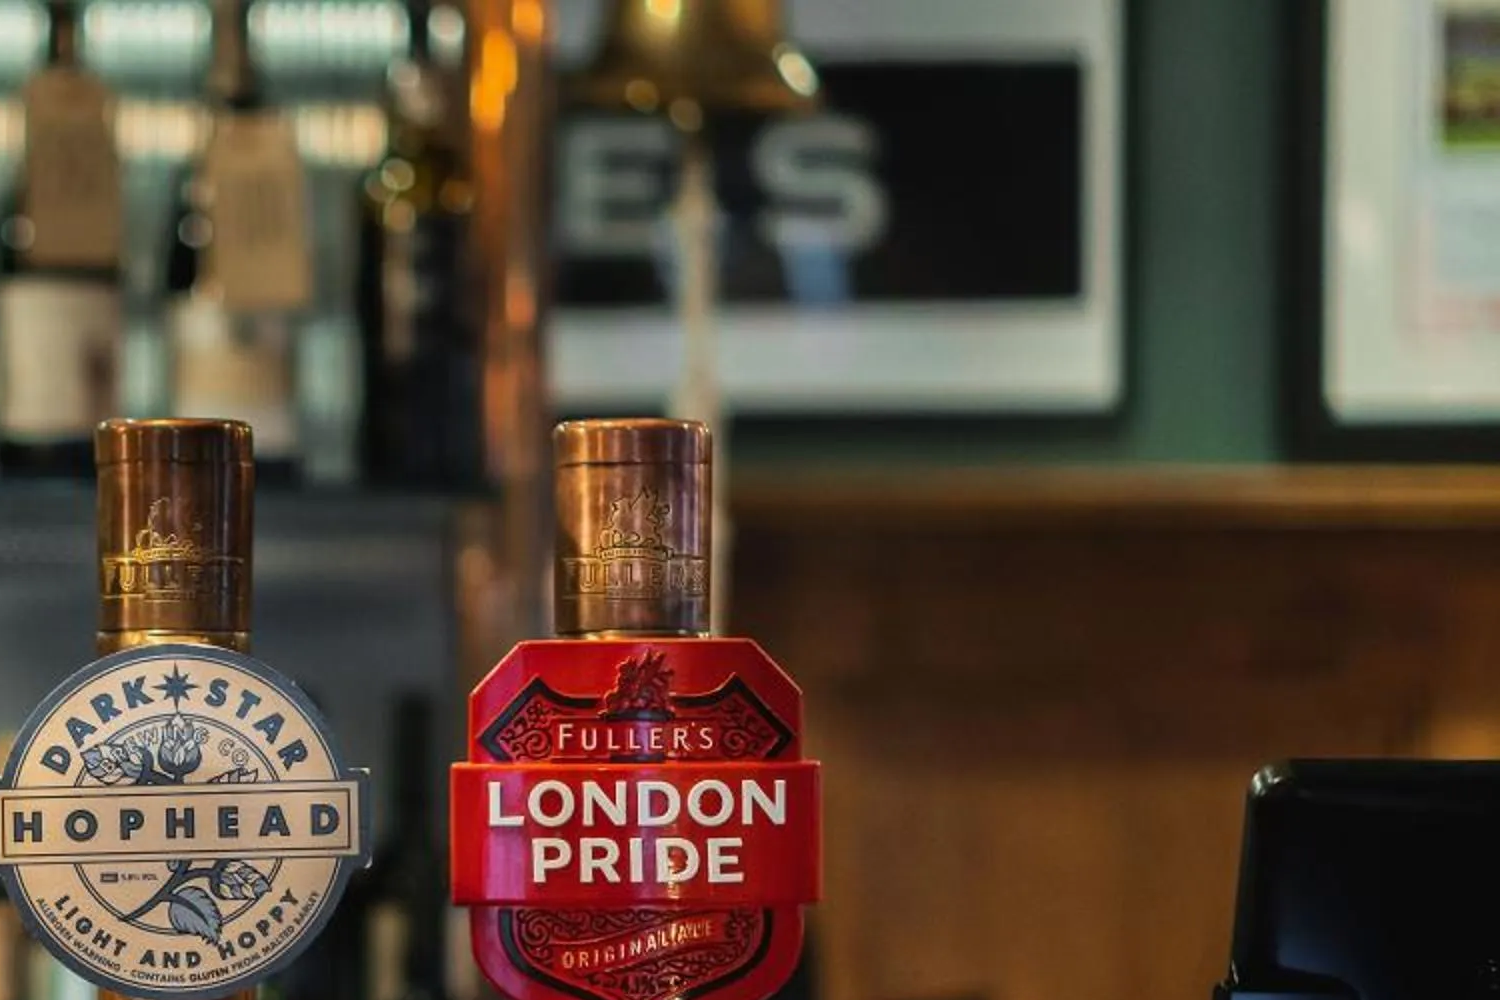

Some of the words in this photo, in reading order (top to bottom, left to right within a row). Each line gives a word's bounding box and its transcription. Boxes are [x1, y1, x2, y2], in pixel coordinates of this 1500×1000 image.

[40, 675, 156, 776] DARK
[203, 677, 309, 771] STAR
[557, 721, 715, 752] FULLER'S
[12, 803, 341, 843] HOPHEAD
[486, 779, 787, 828] LONDON
[531, 836, 746, 884] PRIDE
[55, 895, 127, 957] LIGHT
[139, 949, 201, 969] AND
[218, 888, 299, 960] HOPPY
[561, 929, 669, 969] ORIGINAL
